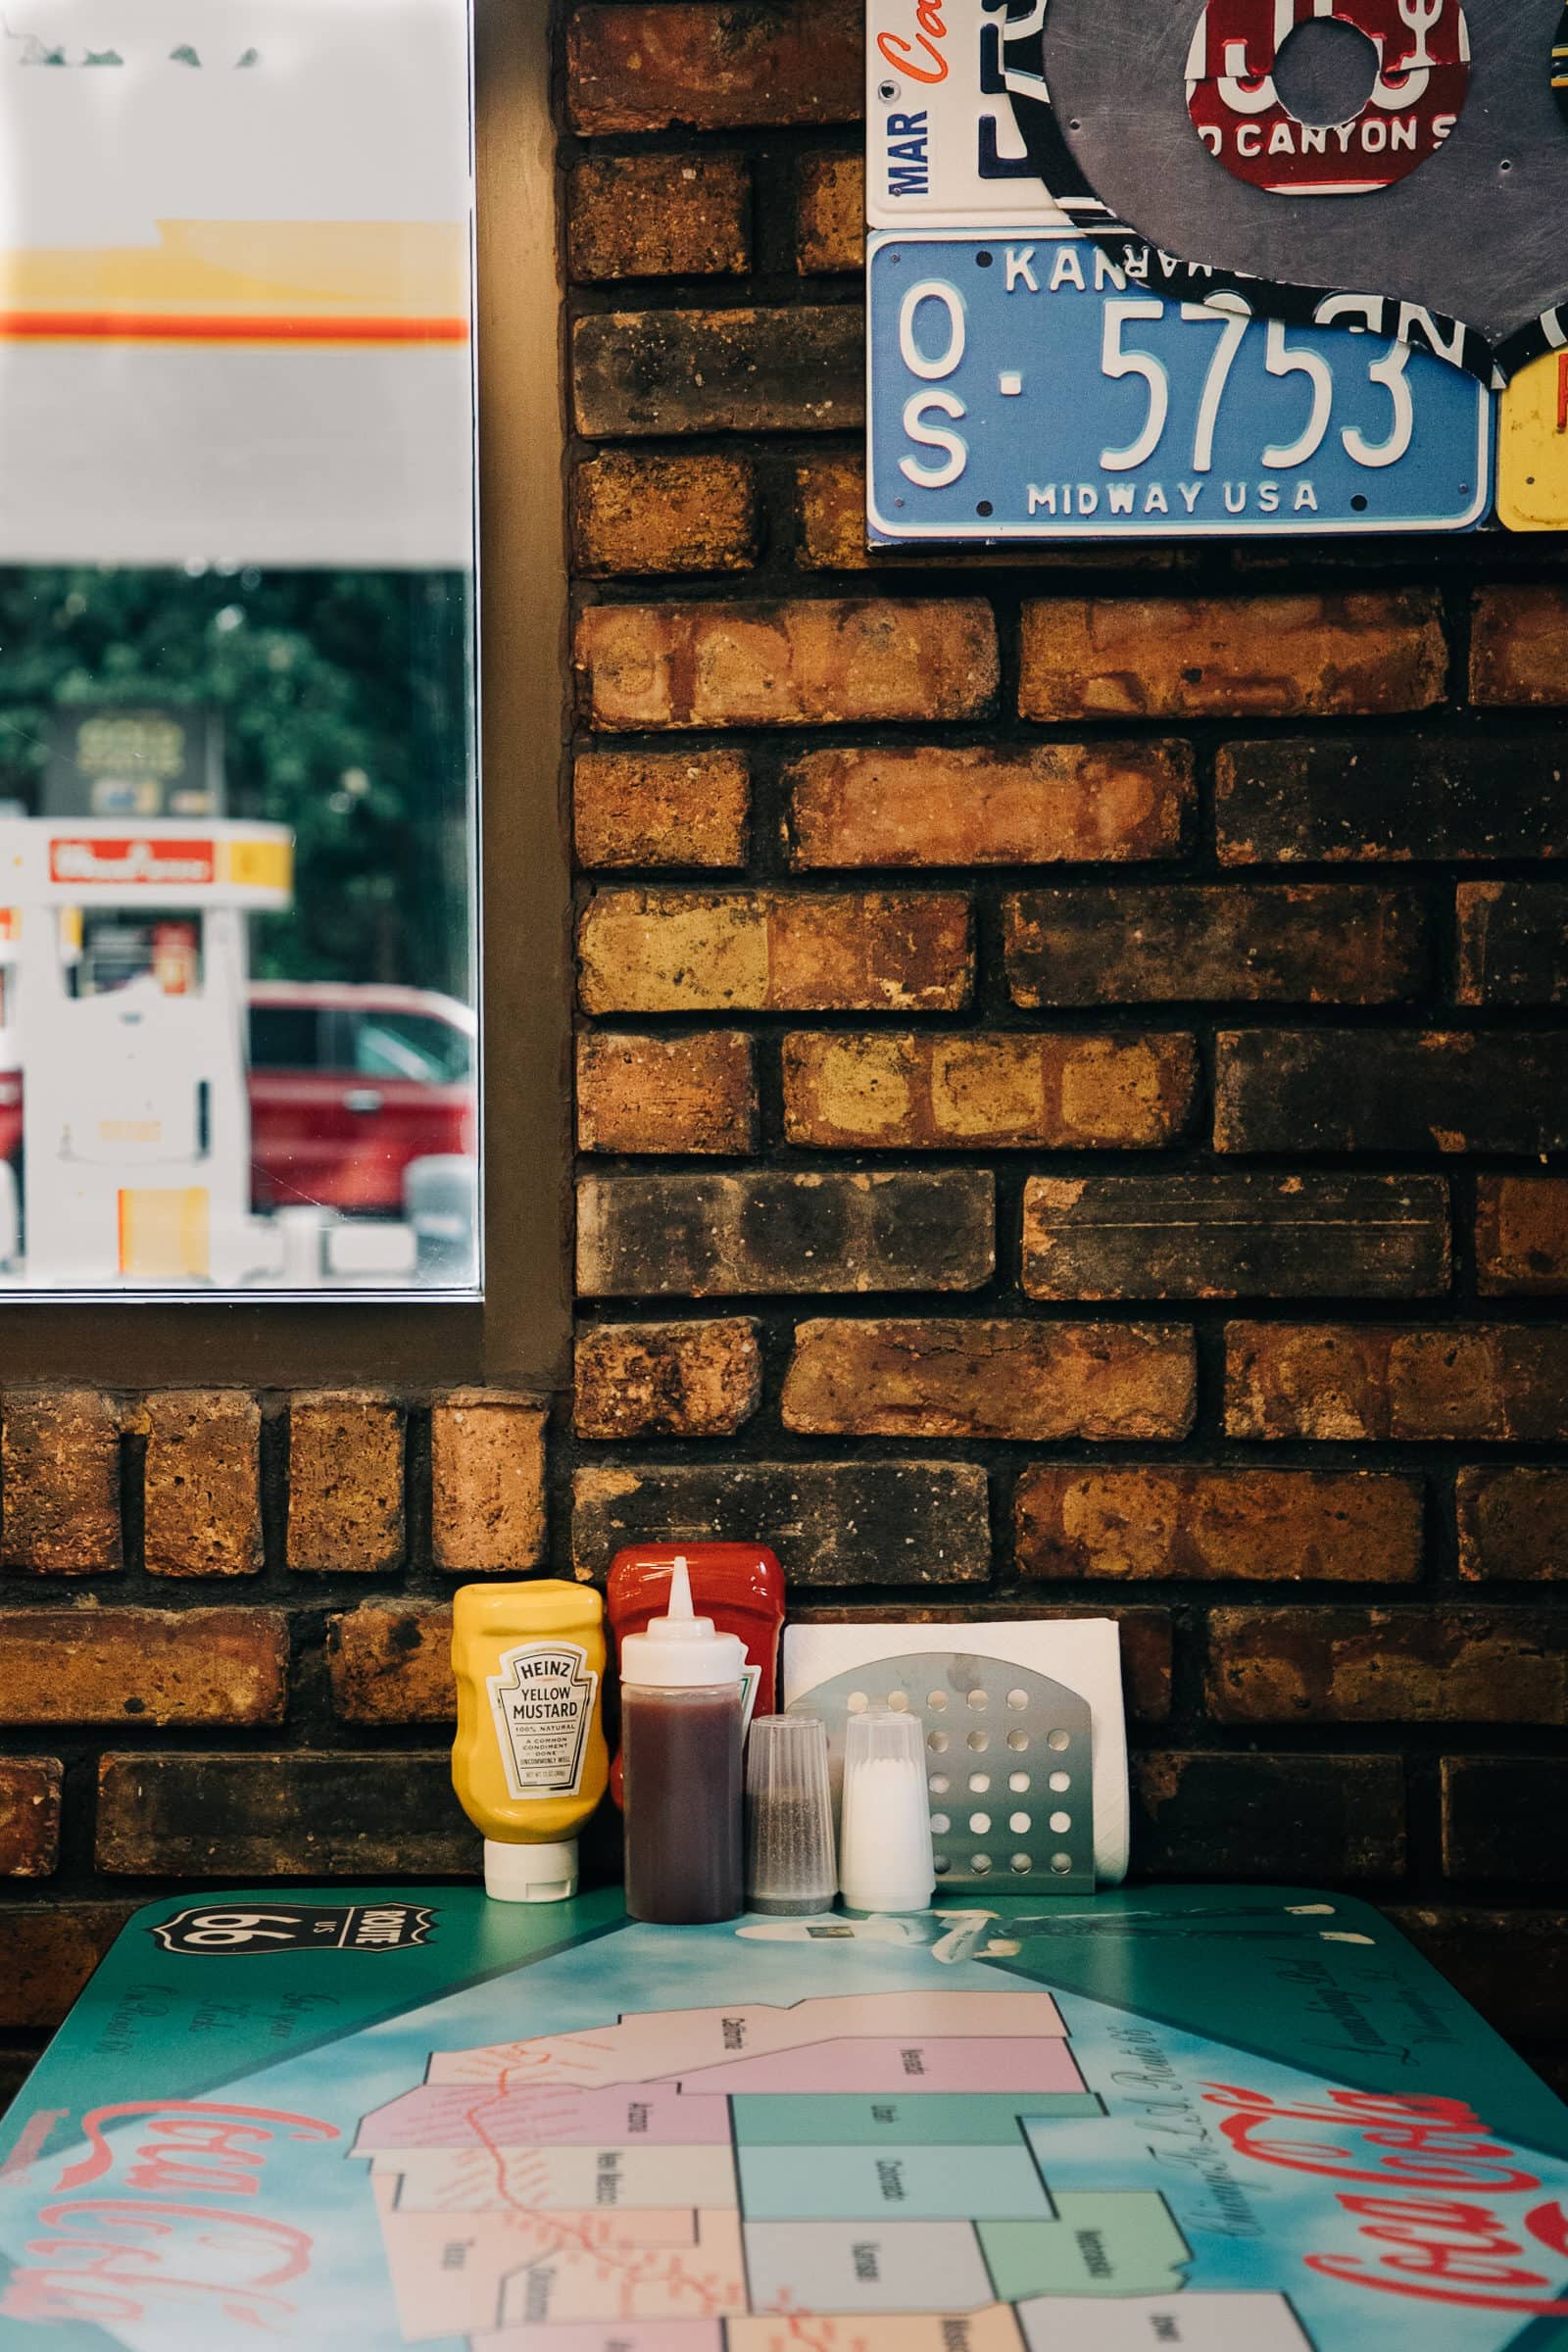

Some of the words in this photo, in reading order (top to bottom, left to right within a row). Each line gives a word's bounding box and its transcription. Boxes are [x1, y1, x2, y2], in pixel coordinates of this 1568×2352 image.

[887, 111, 929, 195] MAR
[1235, 120, 1418, 157] CANYON
[1028, 483, 1202, 515] MIDWAY
[1224, 480, 1318, 514] USA
[520, 1660, 571, 1680] HEINZ
[513, 1701, 578, 1719] MUSTARD
[521, 1687, 571, 1701] YELLOW
[182, 1913, 302, 1945] 66
[313, 1921, 337, 1934] US
[355, 1910, 407, 1944] ROUTE
[720, 2017, 743, 2051] California
[51, 2099, 340, 2194] Coca
[1189, 2082, 1542, 2194] Cola
[0, 2200, 312, 2324] Cola
[1303, 2192, 1568, 2317] Coca
